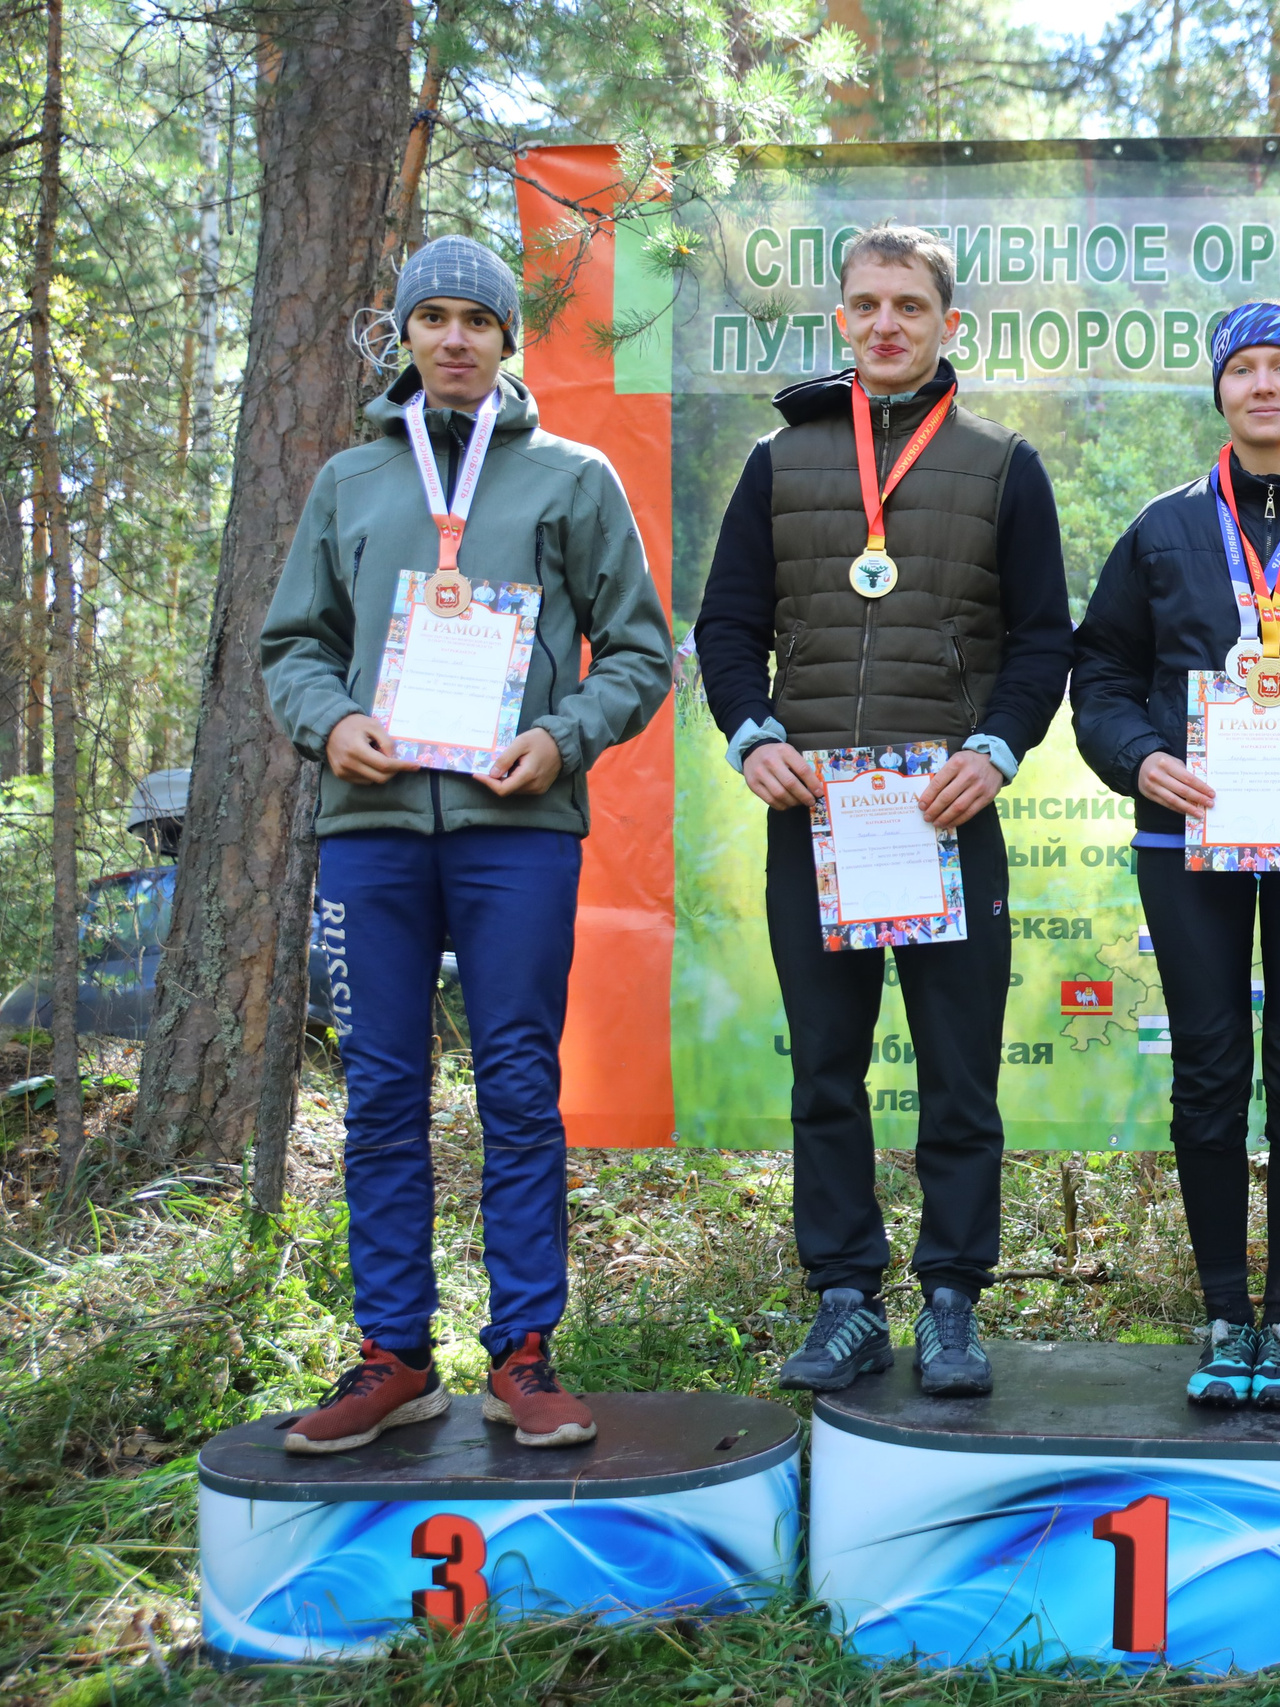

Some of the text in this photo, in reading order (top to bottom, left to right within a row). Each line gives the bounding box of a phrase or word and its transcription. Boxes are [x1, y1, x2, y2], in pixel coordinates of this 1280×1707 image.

[745, 224, 1168, 287] СПИВНОЕ
[415, 428, 438, 498] ЧЕЛЯБИНСКАЯ
[461, 455, 479, 499] ОБЛАСТЬ
[893, 444, 920, 480] ОБЛАСТЬ
[840, 791, 920, 808] ГРАМОТА
[323, 898, 353, 1038] RUSSIA
[411, 1512, 488, 1638] 3
[1093, 1494, 1169, 1654] 1
